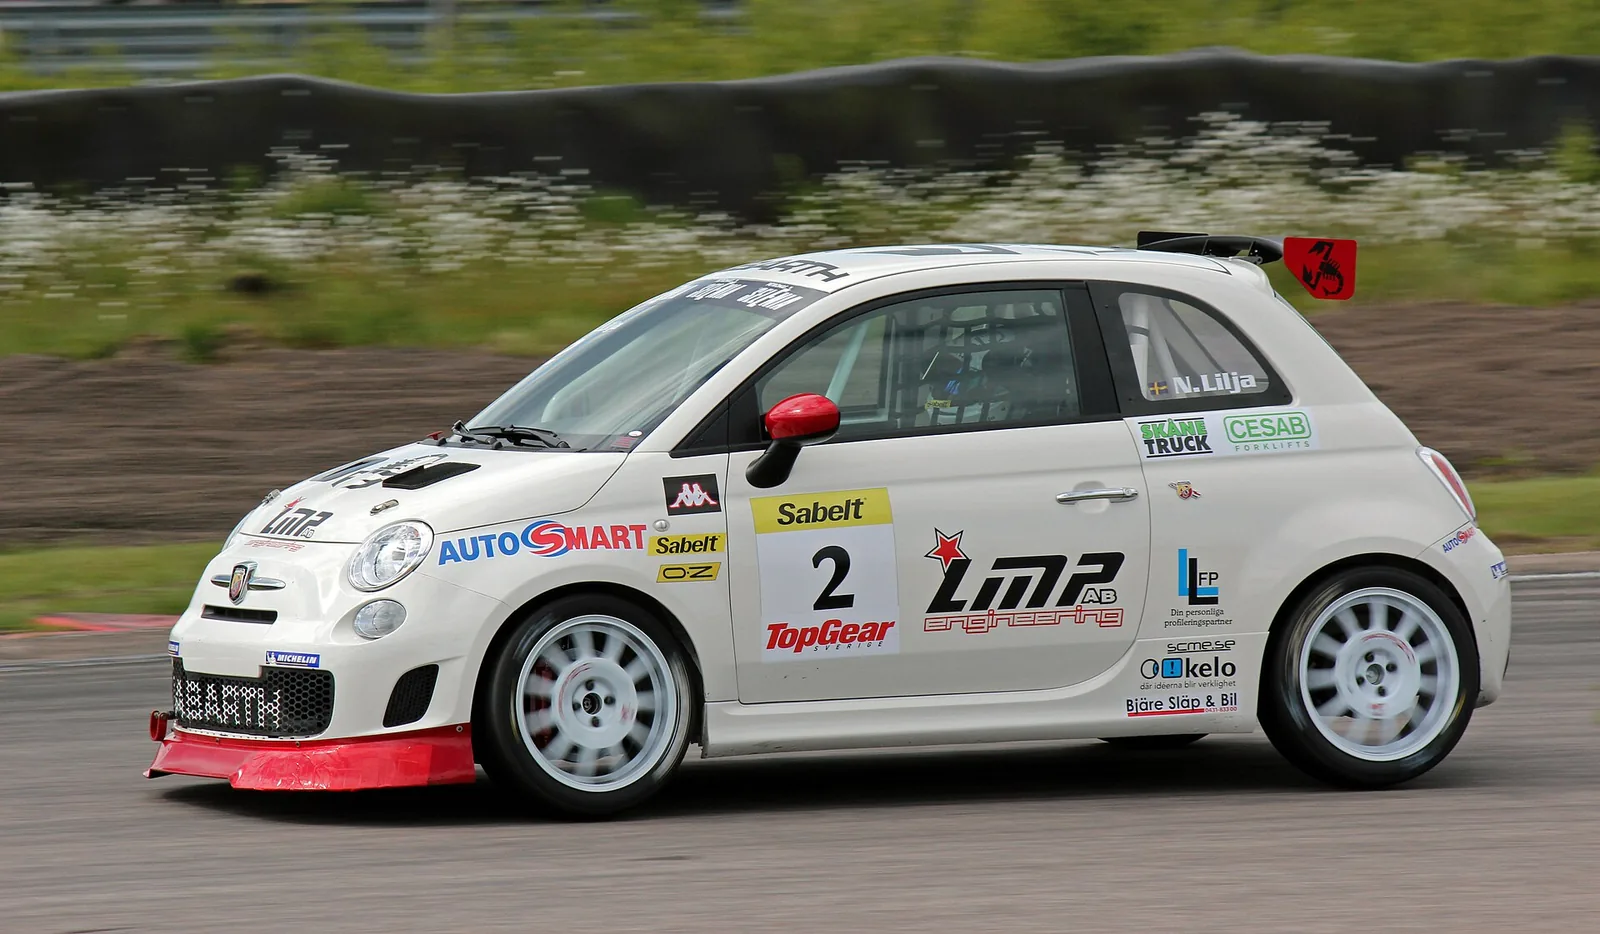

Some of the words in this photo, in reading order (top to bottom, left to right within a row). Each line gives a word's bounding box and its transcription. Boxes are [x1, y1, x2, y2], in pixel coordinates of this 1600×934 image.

[1140, 418, 1208, 439] SKÅNE
[1229, 416, 1306, 439] CESAB
[1144, 435, 1213, 455] TRUCK
[1235, 440, 1310, 452] FORKLIFTS
[777, 498, 864, 525] Sabelt
[655, 536, 719, 555] Sabelt
[811, 545, 855, 611] 2
[925, 551, 1125, 614] LMP
[1082, 588, 1117, 604] AB
[923, 605, 1124, 634] engineering
[1170, 609, 1184, 617] Din
[1185, 607, 1225, 619] personliga
[1164, 618, 1233, 629] profileringspartner
[766, 619, 896, 653] TopGear
[813, 640, 884, 652] SVERIGE
[1167, 639, 1236, 653] scme.se
[277, 655, 317, 664] MICHELIN
[1184, 679, 1197, 689] blir
[1198, 679, 1237, 689] verklighet
[1126, 697, 1164, 714] Bjäre
[1168, 695, 1201, 710] Släp
[1205, 695, 1216, 707] &
[1221, 692, 1237, 706] Bil
